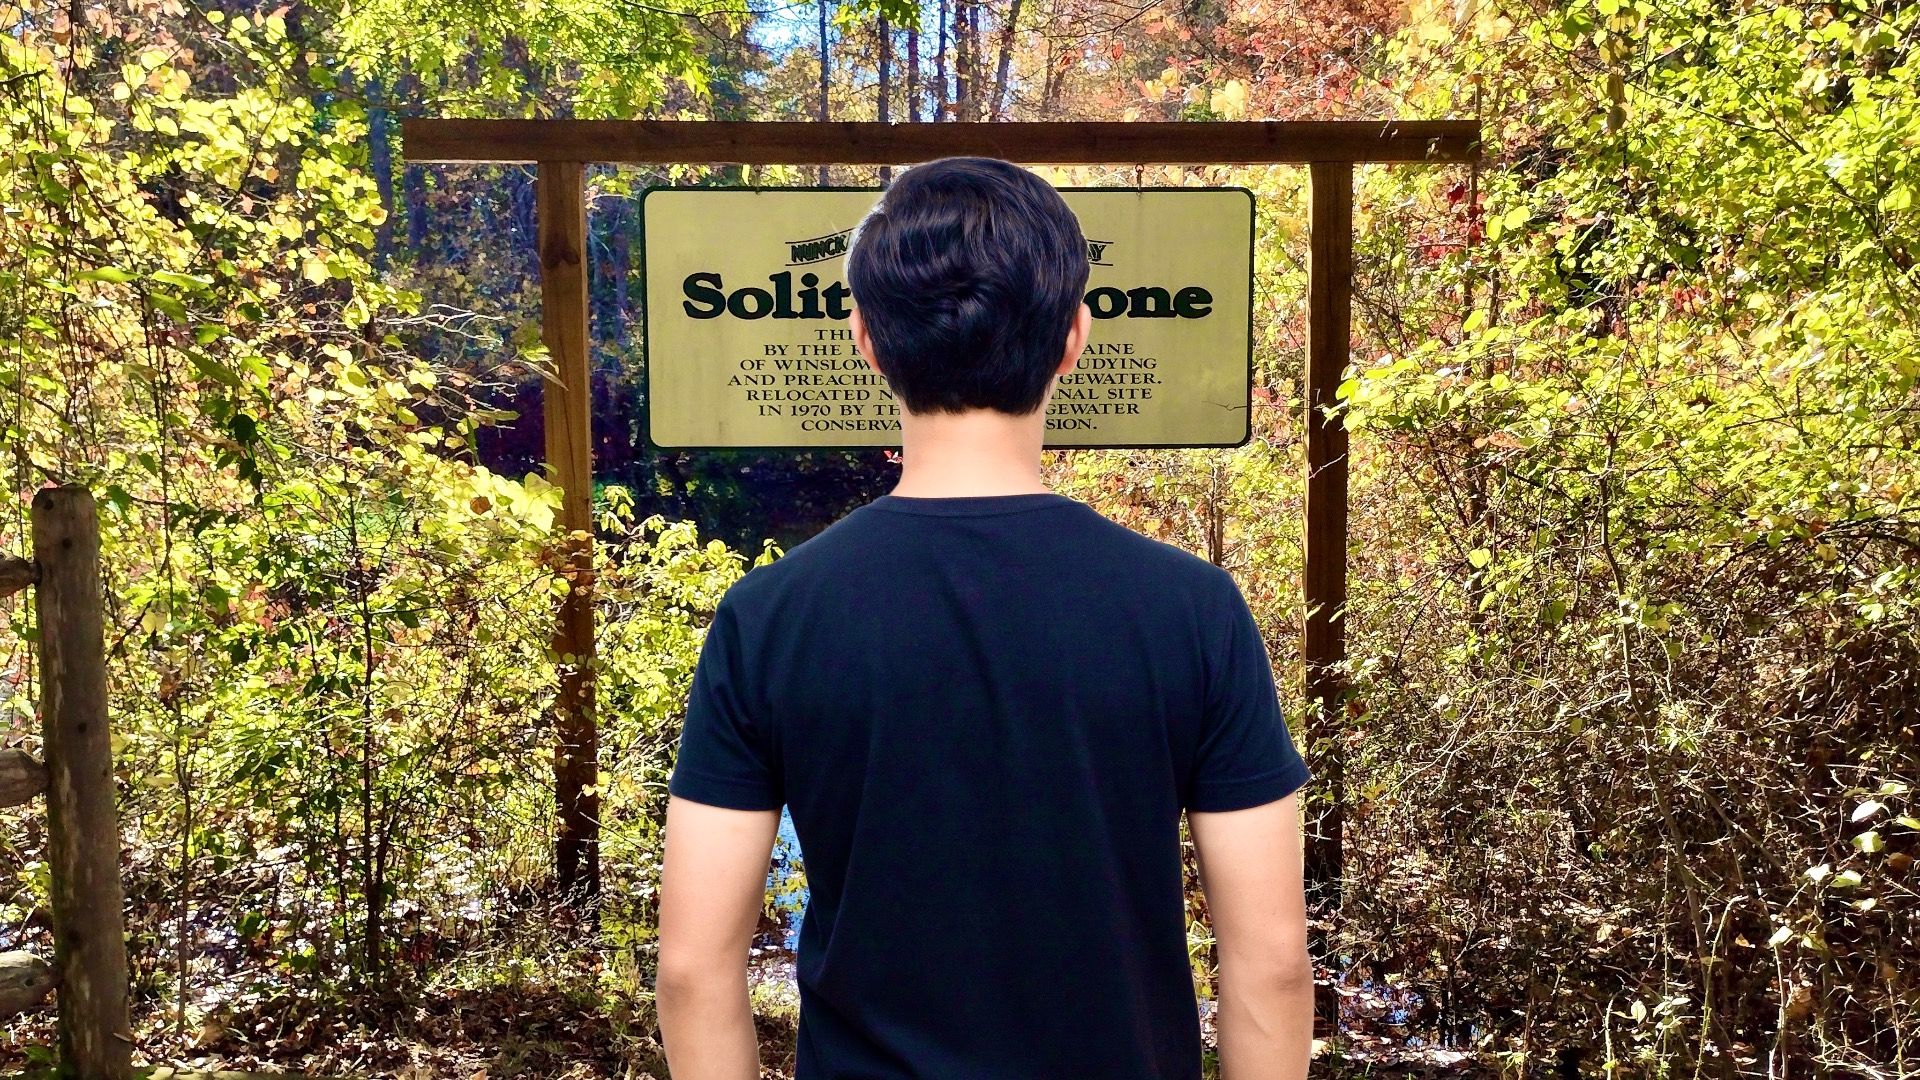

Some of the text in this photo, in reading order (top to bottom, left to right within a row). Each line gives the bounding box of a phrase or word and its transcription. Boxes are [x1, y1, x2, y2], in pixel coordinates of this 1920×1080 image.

[791, 232, 852, 263] NUNCK
[1082, 286, 1213, 319] one
[763, 344, 790, 356] BY
[797, 344, 842, 356] THE
[1082, 343, 1135, 355] AINE
[740, 359, 766, 371] OF
[727, 374, 776, 386] AND
[746, 390, 870, 401] RELOCATED
[1107, 388, 1153, 400] SITE
[758, 404, 782, 416] IN
[790, 404, 831, 416] 1970
[840, 404, 865, 416] BY
[801, 419, 1097, 431] CONSERVA SION.
